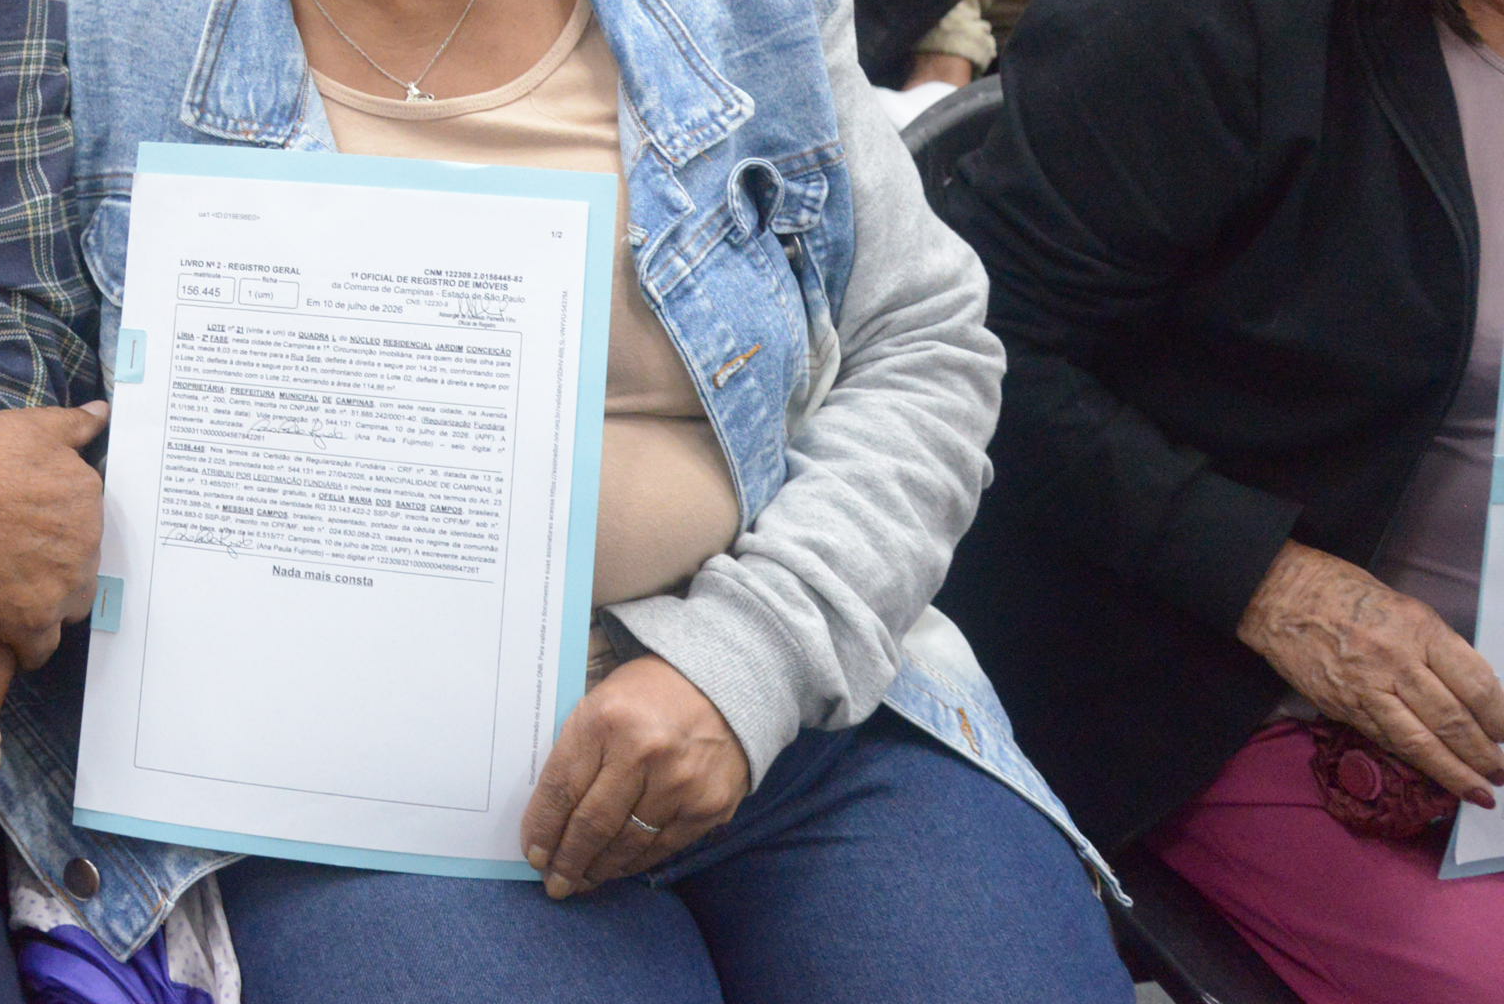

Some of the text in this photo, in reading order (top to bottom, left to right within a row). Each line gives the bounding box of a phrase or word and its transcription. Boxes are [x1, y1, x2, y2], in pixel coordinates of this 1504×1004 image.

[551, 230, 563, 239] 1/2
[180, 258, 204, 268] LIVRO
[216, 261, 221, 269] 2
[228, 262, 270, 273] REGISTRO
[272, 265, 301, 276] GERAL
[424, 268, 442, 277] CNM
[262, 276, 278, 284] ficha
[360, 272, 394, 282] OFICIAL
[397, 275, 408, 284] DE
[411, 276, 456, 287] REGISTRO
[458, 280, 470, 288] DE
[473, 280, 509, 292] IMÓVEIS
[182, 285, 221, 297] 156.445
[254, 290, 274, 301] (um)
[343, 282, 379, 292] Comarca
[382, 285, 392, 293] de
[394, 285, 434, 298] Campinas
[441, 289, 469, 299] Estado
[471, 292, 482, 300] de
[484, 292, 500, 302] São
[502, 294, 526, 304] Paulo
[306, 298, 403, 314] Em 10 de julho de 2026
[207, 323, 226, 333] LOTE
[298, 331, 329, 342] QUADRA
[382, 338, 433, 351] RESIDENCIAL
[435, 343, 463, 353] JARDIM
[465, 344, 511, 357] CONCEIÇÃO
[251, 339, 272, 347] cidade
[283, 342, 315, 352] Campinas
[416, 354, 431, 363] para
[433, 356, 452, 364] quem
[454, 356, 463, 364] do
[465, 357, 477, 365] lote
[496, 361, 511, 369] para
[239, 348, 248, 356] de
[269, 352, 283, 360] para
[383, 362, 403, 371] segue
[449, 367, 493, 377] confrontando
[262, 363, 281, 371] segue
[386, 373, 401, 381] Lote
[476, 382, 497, 391] segue
[498, 384, 509, 392] por
[230, 387, 275, 399] PREFEITURA
[279, 391, 318, 403] MUNICIPAL
[322, 395, 332, 404] DE
[480, 411, 508, 420] Avenida
[376, 435, 396, 444] Paula
[419, 428, 435, 437] julho
[201, 468, 234, 479] ATRIBUIU
[235, 471, 251, 480] POR
[375, 475, 437, 488] MUNICIPALIDADE
[222, 505, 254, 516] MESSIAS
[348, 496, 372, 506] MARIA
[375, 498, 392, 508] DOS
[395, 500, 426, 512] SANTOS
[272, 564, 374, 587] Nada mais consta
